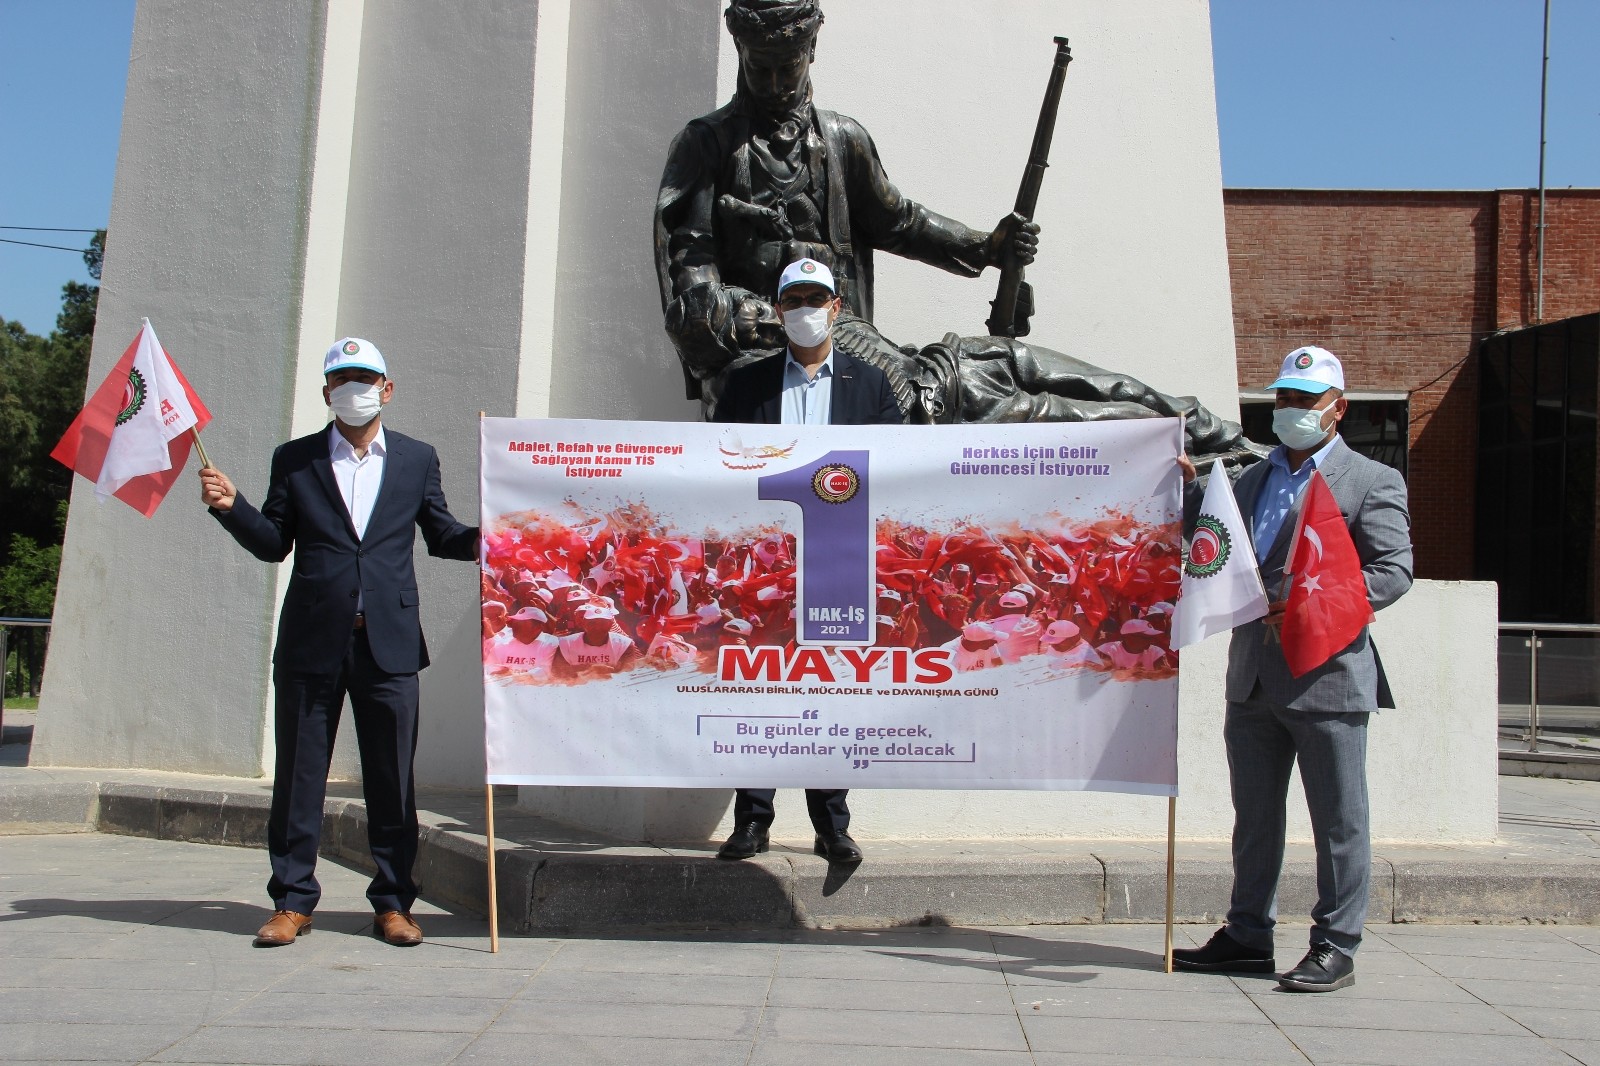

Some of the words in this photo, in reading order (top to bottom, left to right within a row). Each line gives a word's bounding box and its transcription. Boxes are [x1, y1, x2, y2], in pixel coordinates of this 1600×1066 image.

[508, 441, 554, 453] Adalet,
[556, 442, 594, 452] Refah
[597, 444, 612, 453] ve
[615, 443, 683, 455] Güvenceyi
[962, 446, 1019, 459] Herkes
[1023, 444, 1055, 461] İçin
[1059, 446, 1098, 459] Gelir
[532, 454, 592, 466] Sağlayan
[594, 455, 632, 465] Kamu
[950, 461, 1035, 476] Güvencesi
[1039, 460, 1110, 477] İstiyoruz
[565, 465, 622, 478] İstiyoruz
[757, 450, 869, 641] 1
[808, 605, 865, 625] HAK-İŞ
[820, 625, 850, 635] 2021
[721, 648, 954, 685] MAYIS
[676, 685, 765, 694] ULUSLARARASI
[766, 686, 806, 695] BİRLİK,
[808, 686, 873, 696] MÜCADELE
[892, 688, 962, 698] DAYANIŞMA
[963, 688, 999, 697] GÜNÜ
[736, 722, 759, 736] Bu
[764, 722, 823, 740] günler
[828, 723, 850, 737] de
[855, 724, 932, 741] geçecek,
[713, 740, 735, 754] bu
[740, 741, 836, 759] meydanlar
[842, 743, 880, 759] yine
[885, 742, 956, 756] dolacak
